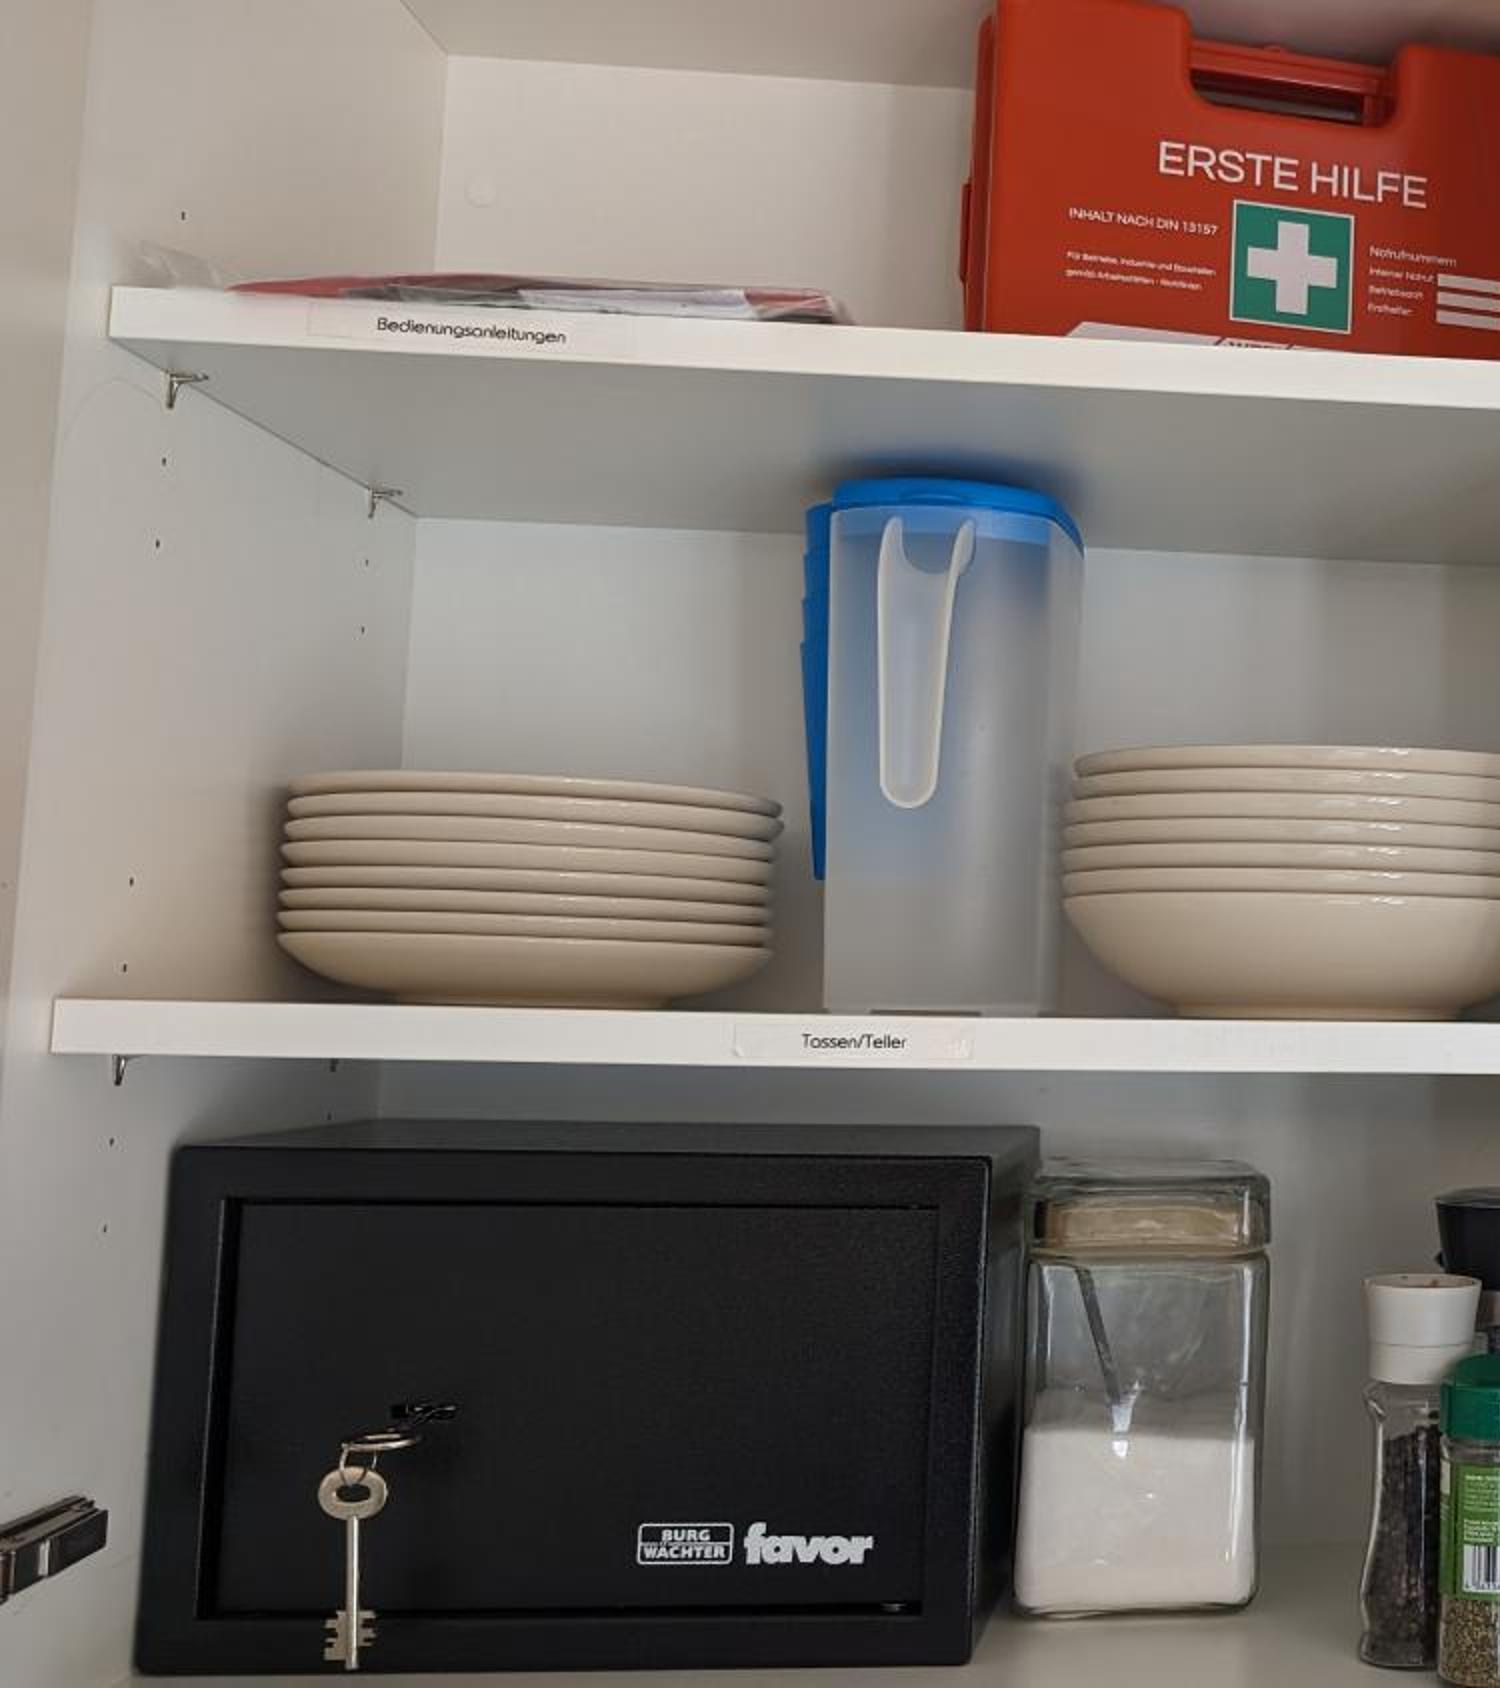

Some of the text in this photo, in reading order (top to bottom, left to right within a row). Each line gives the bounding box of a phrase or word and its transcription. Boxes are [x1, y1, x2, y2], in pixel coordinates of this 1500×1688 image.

[1158, 140, 1428, 209] ERSTE HILFE
[1069, 207, 1219, 236] INHALT NACH DIN 13157
[377, 316, 567, 344] Bedienungsanleitungen
[802, 1032, 907, 1050] Tassen/Teller
[661, 1528, 712, 1542] BURG
[743, 1521, 874, 1565] favor
